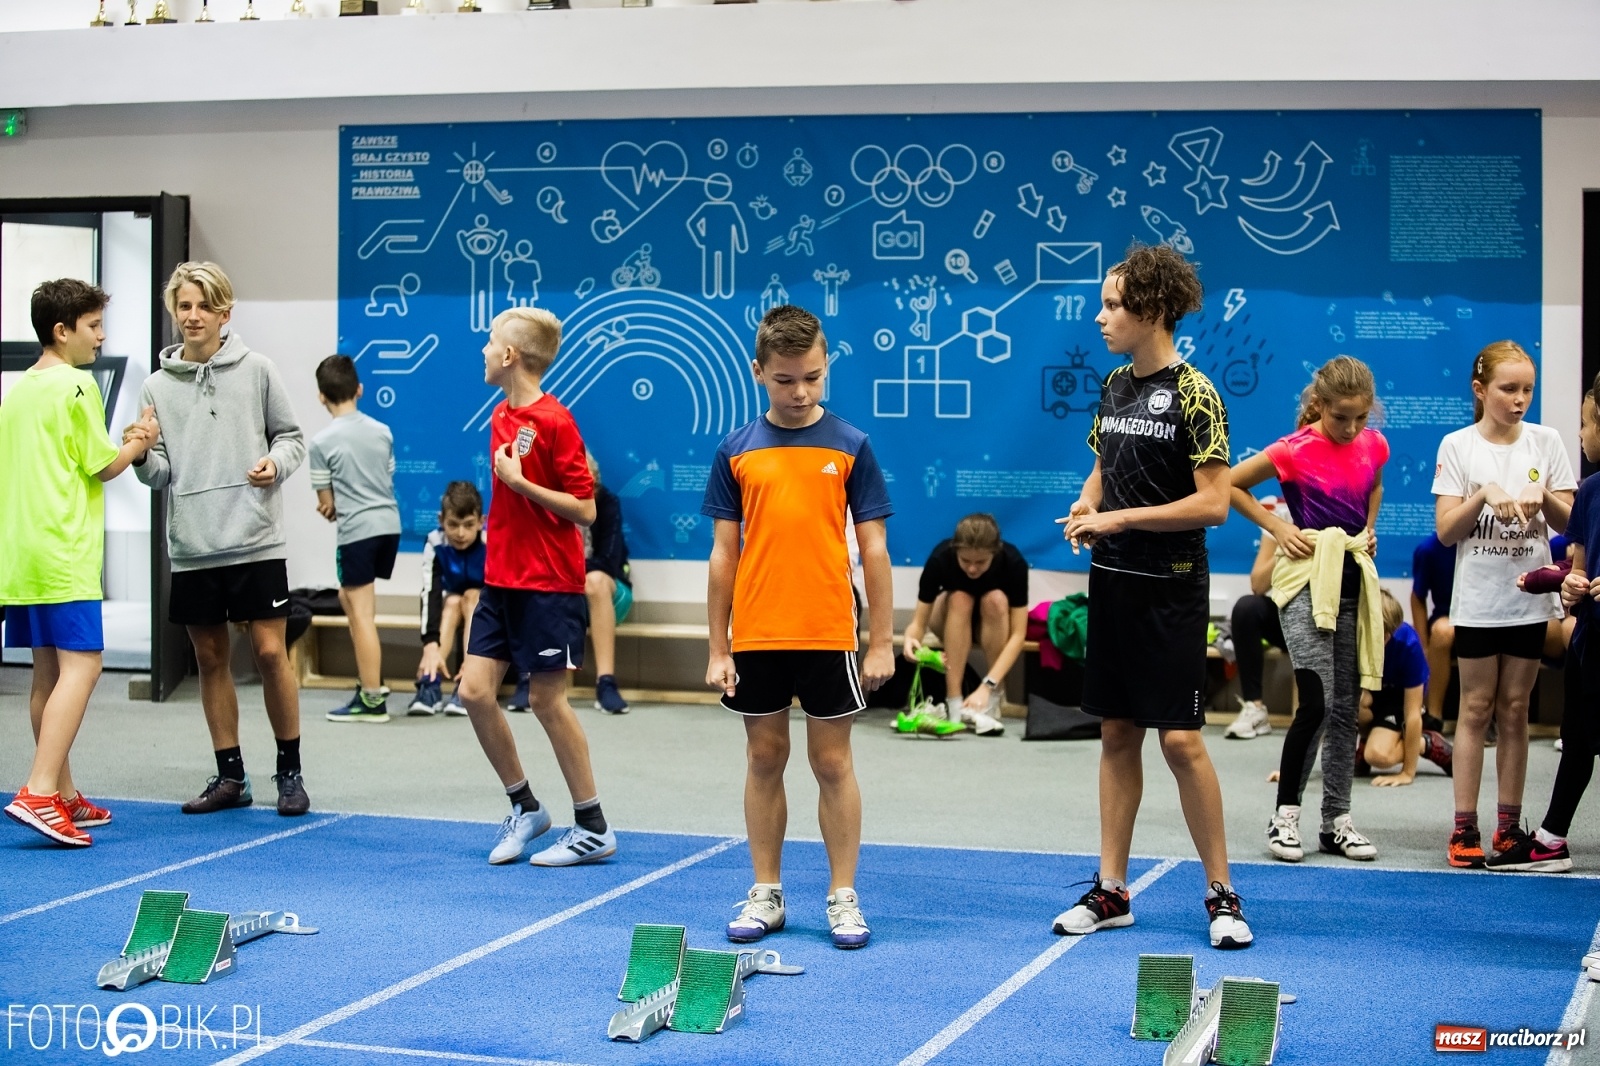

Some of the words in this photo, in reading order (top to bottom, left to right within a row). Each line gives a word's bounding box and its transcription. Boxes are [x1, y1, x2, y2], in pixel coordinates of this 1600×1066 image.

[352, 136, 398, 147] ZAWSZE
[352, 153, 383, 163] GRAJ
[385, 152, 430, 162] CZYSTO
[360, 169, 414, 180] HISTORIA
[352, 186, 420, 197] PRAWDZIWA
[878, 230, 919, 249] GO!
[916, 355, 926, 374] 1
[1473, 546, 1479, 556] 3
[1482, 545, 1509, 556] MAJA
[1512, 545, 1534, 557] 2019
